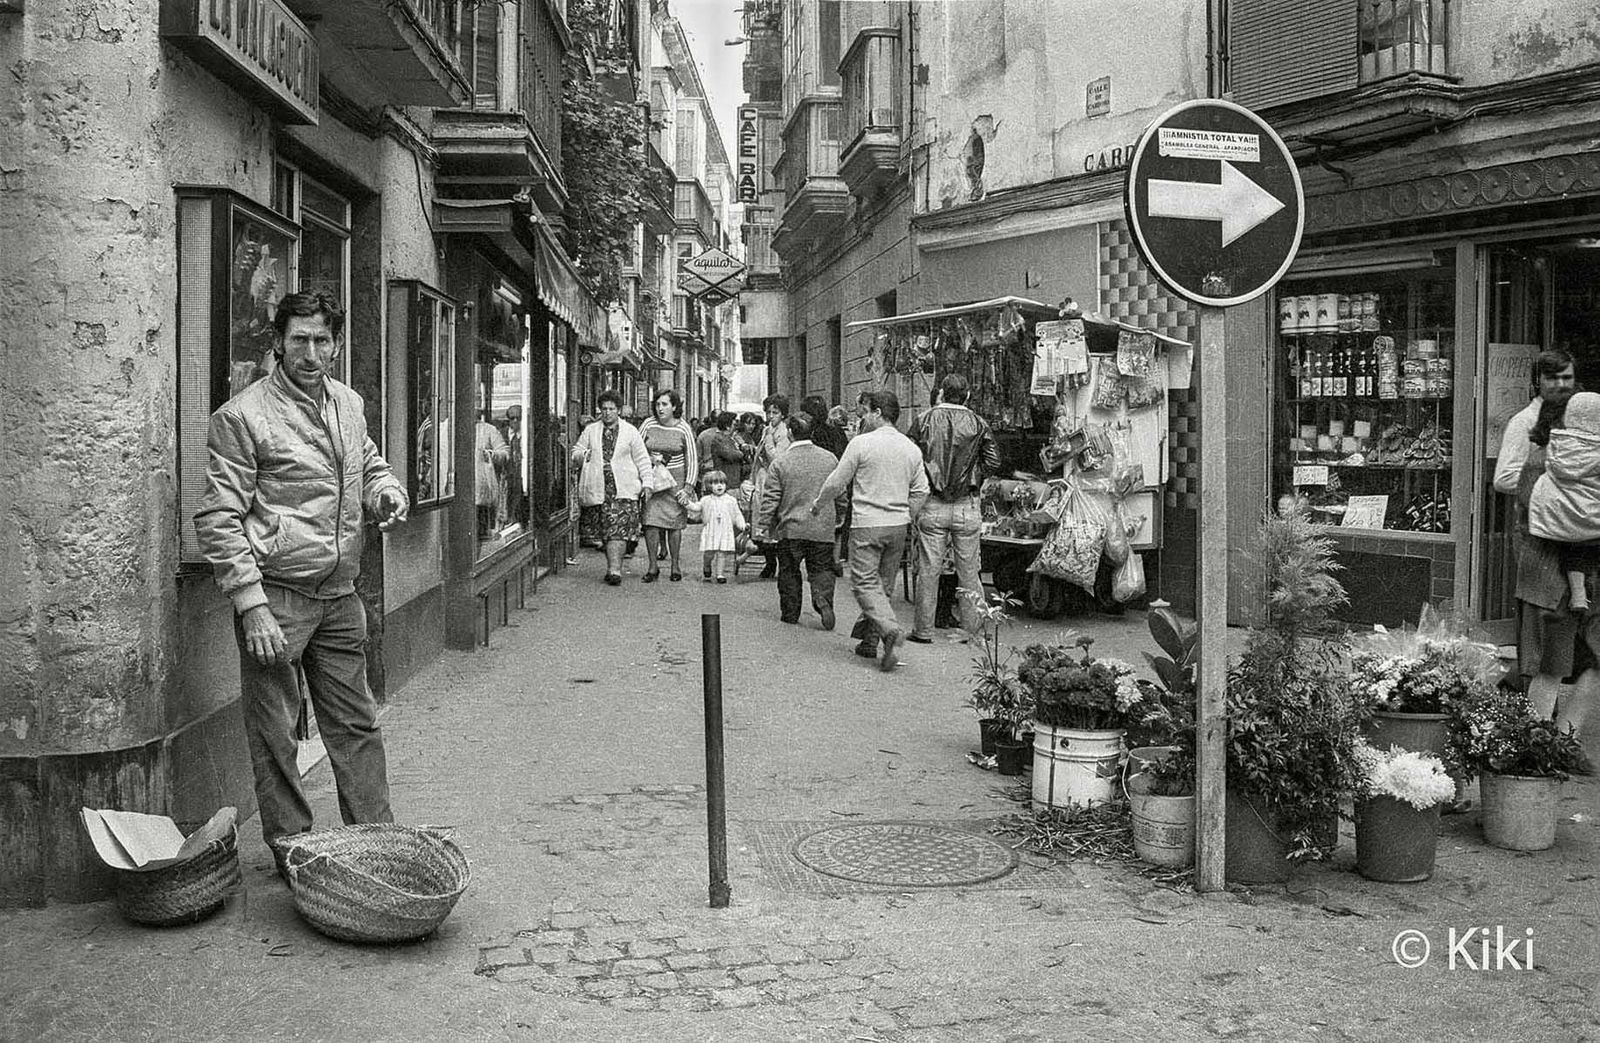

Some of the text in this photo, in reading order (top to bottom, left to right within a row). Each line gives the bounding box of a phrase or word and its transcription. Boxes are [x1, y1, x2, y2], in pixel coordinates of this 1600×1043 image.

[1088, 83, 1108, 95] CALLE
[1211, 134, 1237, 143] TOTAL
[1165, 141, 1193, 149] ASAMBLEA
[1194, 142, 1220, 150] GENERAL
[740, 108, 756, 200] CAFE BAR
